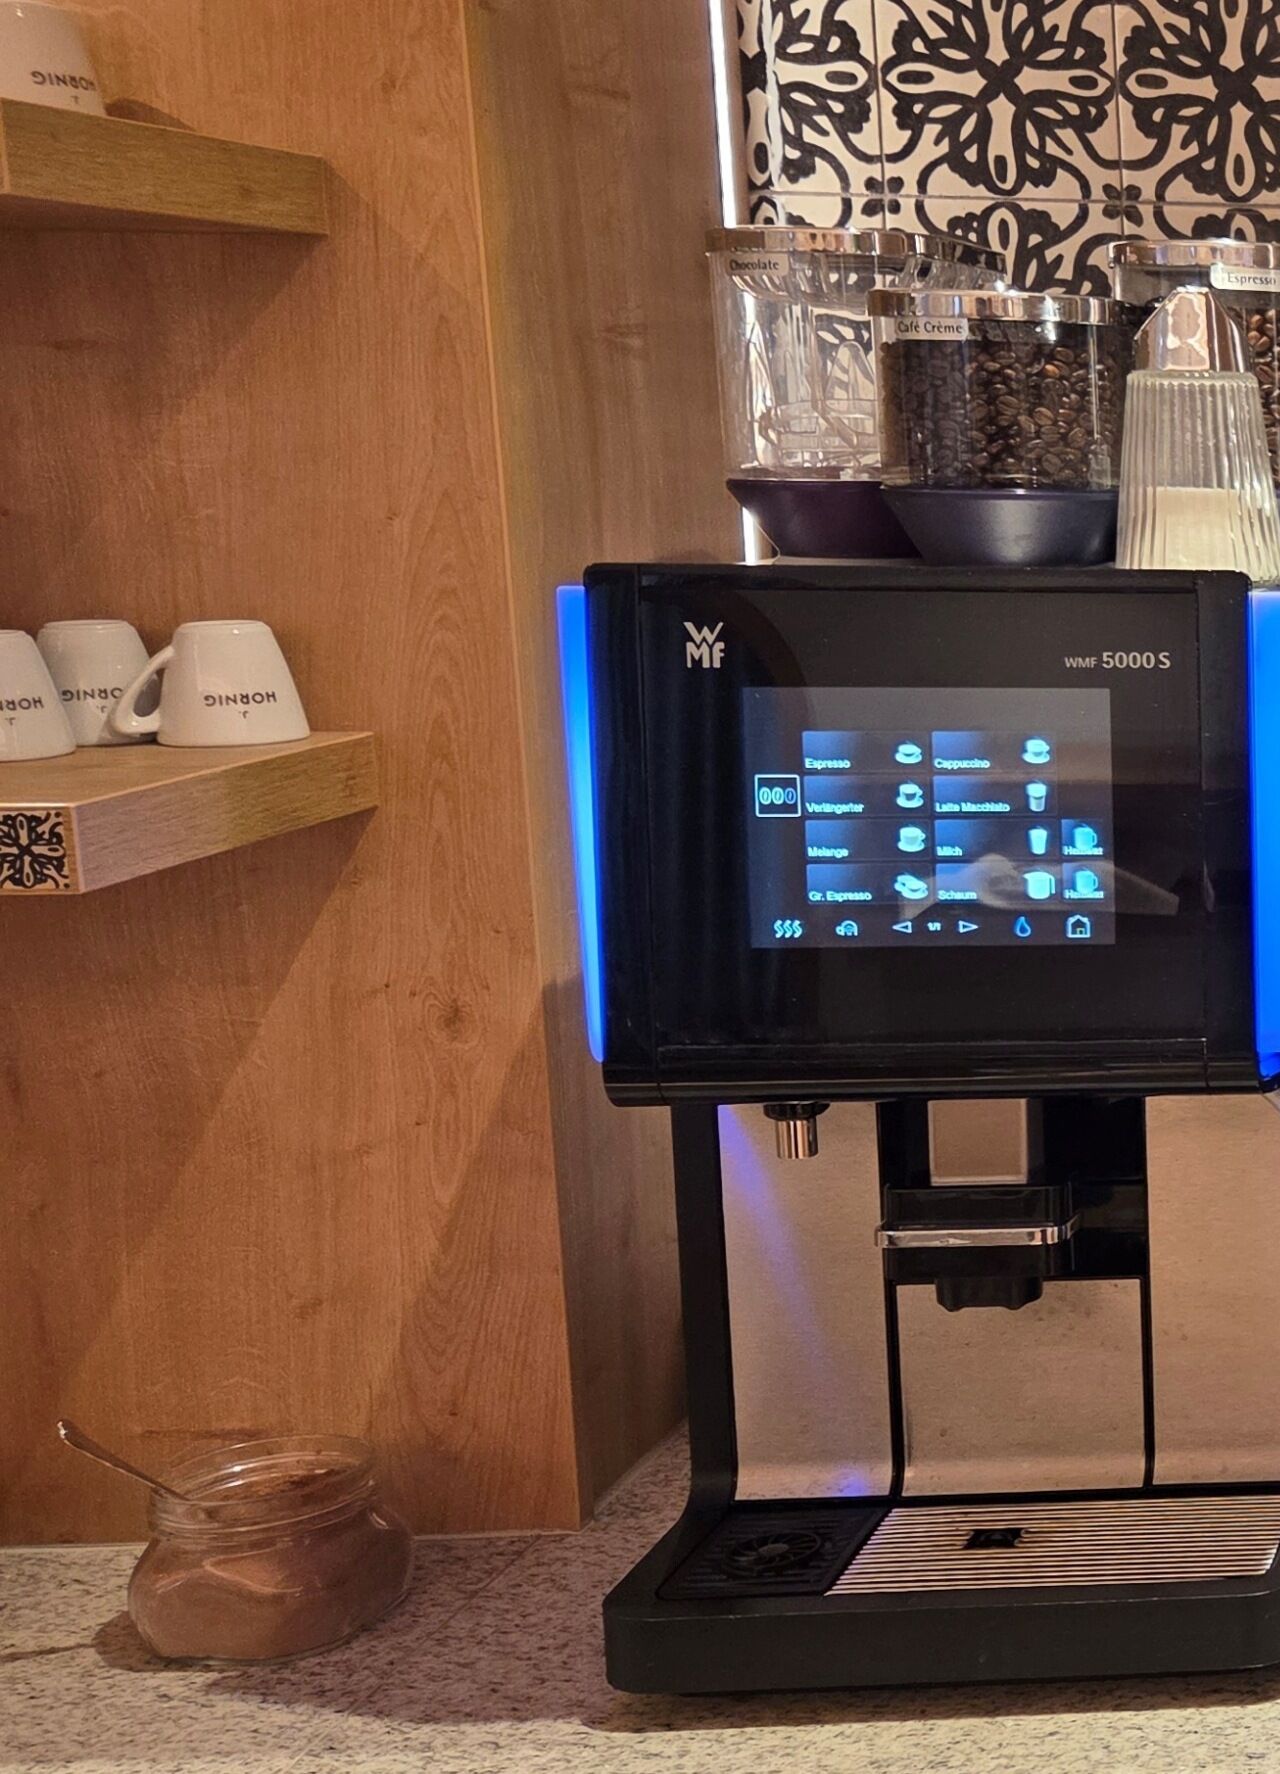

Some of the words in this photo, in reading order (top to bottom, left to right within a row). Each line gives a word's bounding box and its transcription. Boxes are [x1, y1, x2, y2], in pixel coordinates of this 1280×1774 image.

[730, 256, 780, 272] Chocolate
[1227, 271, 1277, 287] Espresso
[899, 321, 921, 335] Café
[924, 320, 963, 336] Crème
[1064, 656, 1098, 669] WMF
[1101, 651, 1156, 669] 5000
[1158, 651, 1172, 669] S
[61, 688, 123, 702] ORNIG
[204, 691, 277, 707] HORNIG
[805, 758, 851, 770] Espresso
[934, 758, 991, 770] Cappuccino
[827, 891, 872, 902] Espresso
